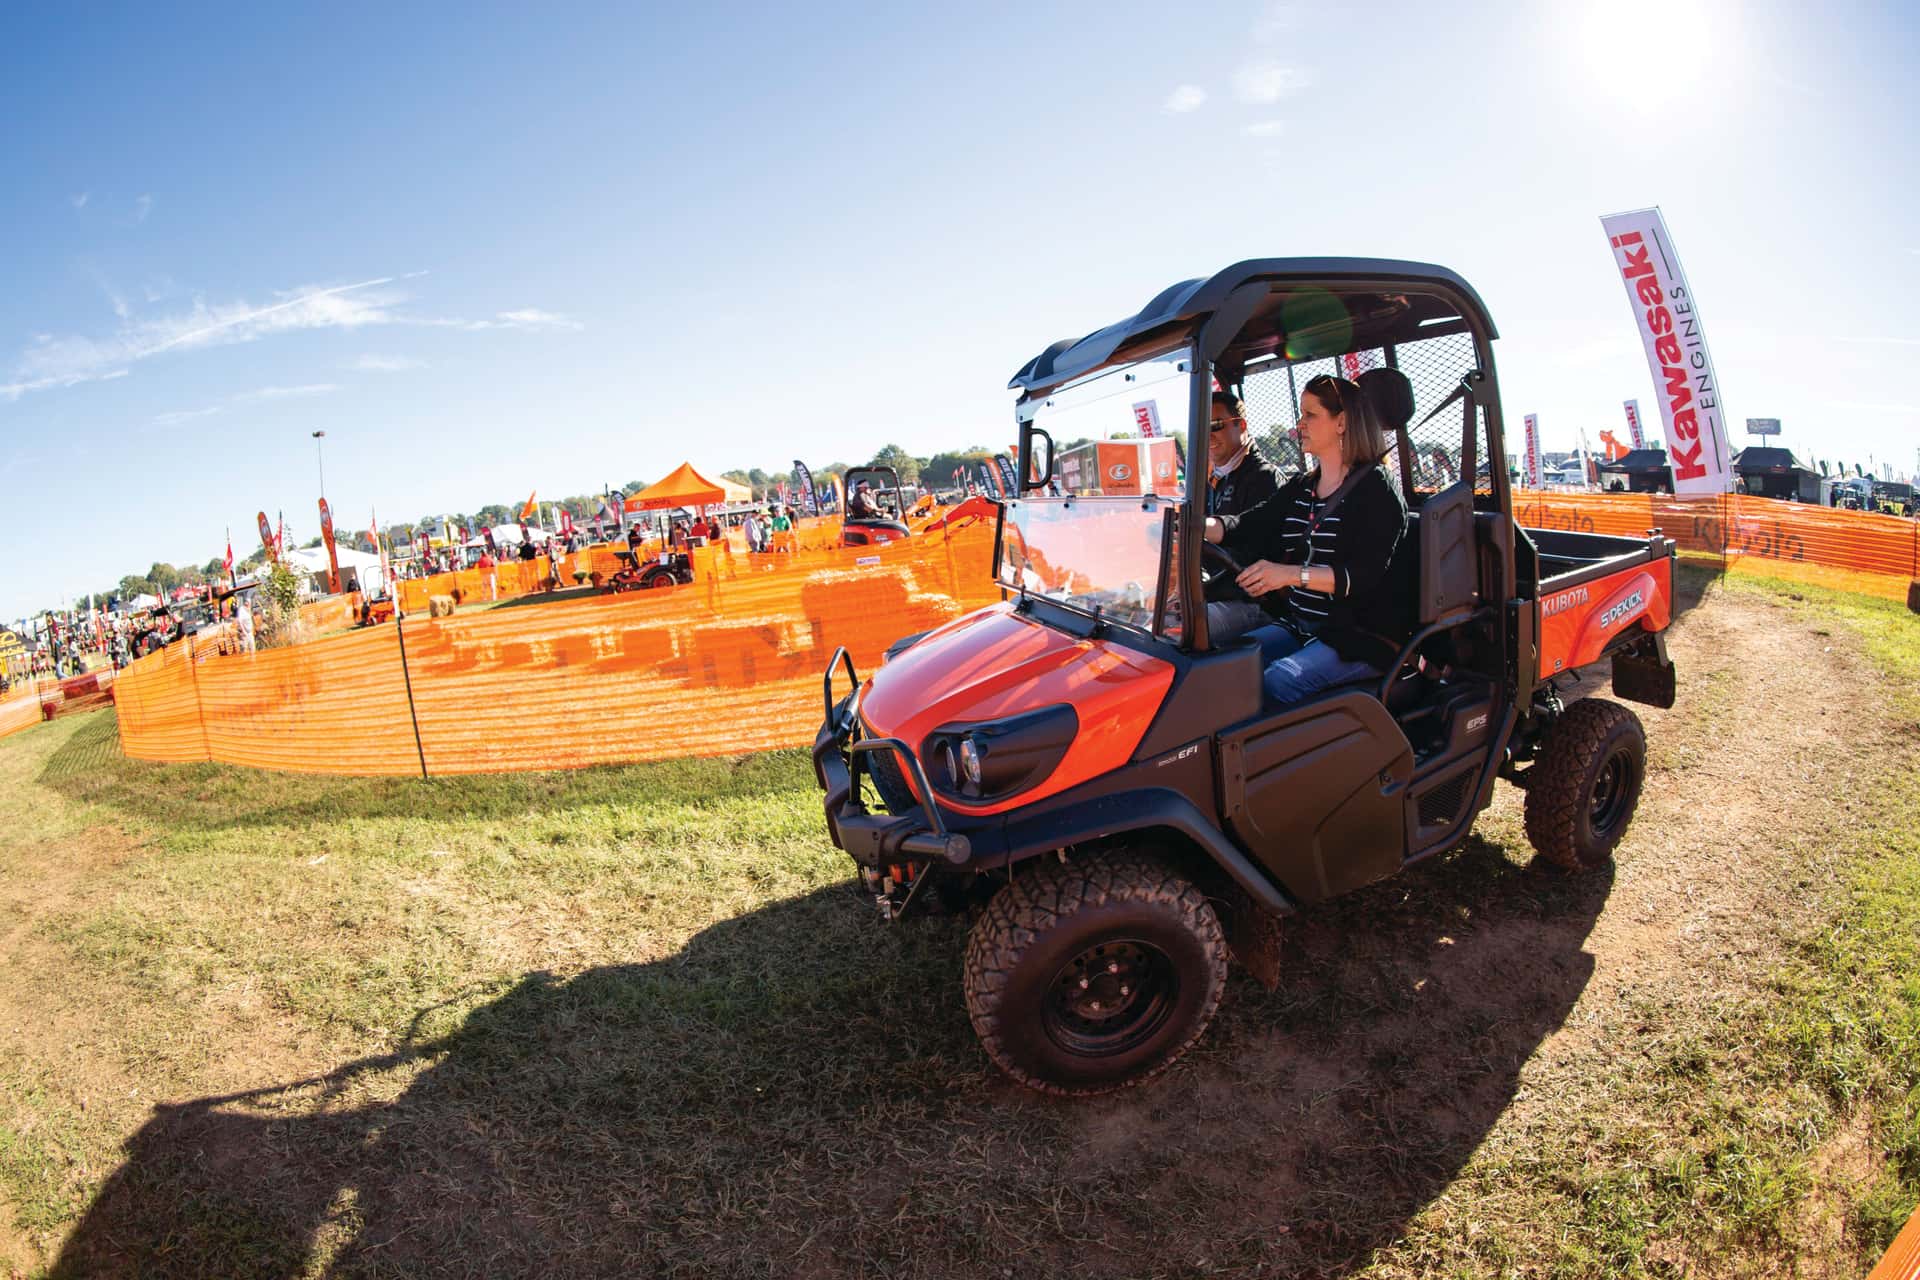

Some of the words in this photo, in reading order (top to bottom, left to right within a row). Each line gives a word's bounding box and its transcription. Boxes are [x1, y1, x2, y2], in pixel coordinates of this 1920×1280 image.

[1610, 231, 1707, 481] Kawasaki
[1670, 286, 1715, 410] ENGINES
[1625, 406, 1641, 448] asaki
[1542, 588, 1589, 617] KUBOTA
[1600, 590, 1643, 629] SIDEKICK
[1466, 714, 1487, 729] EPS
[1178, 745, 1198, 760] EFI
